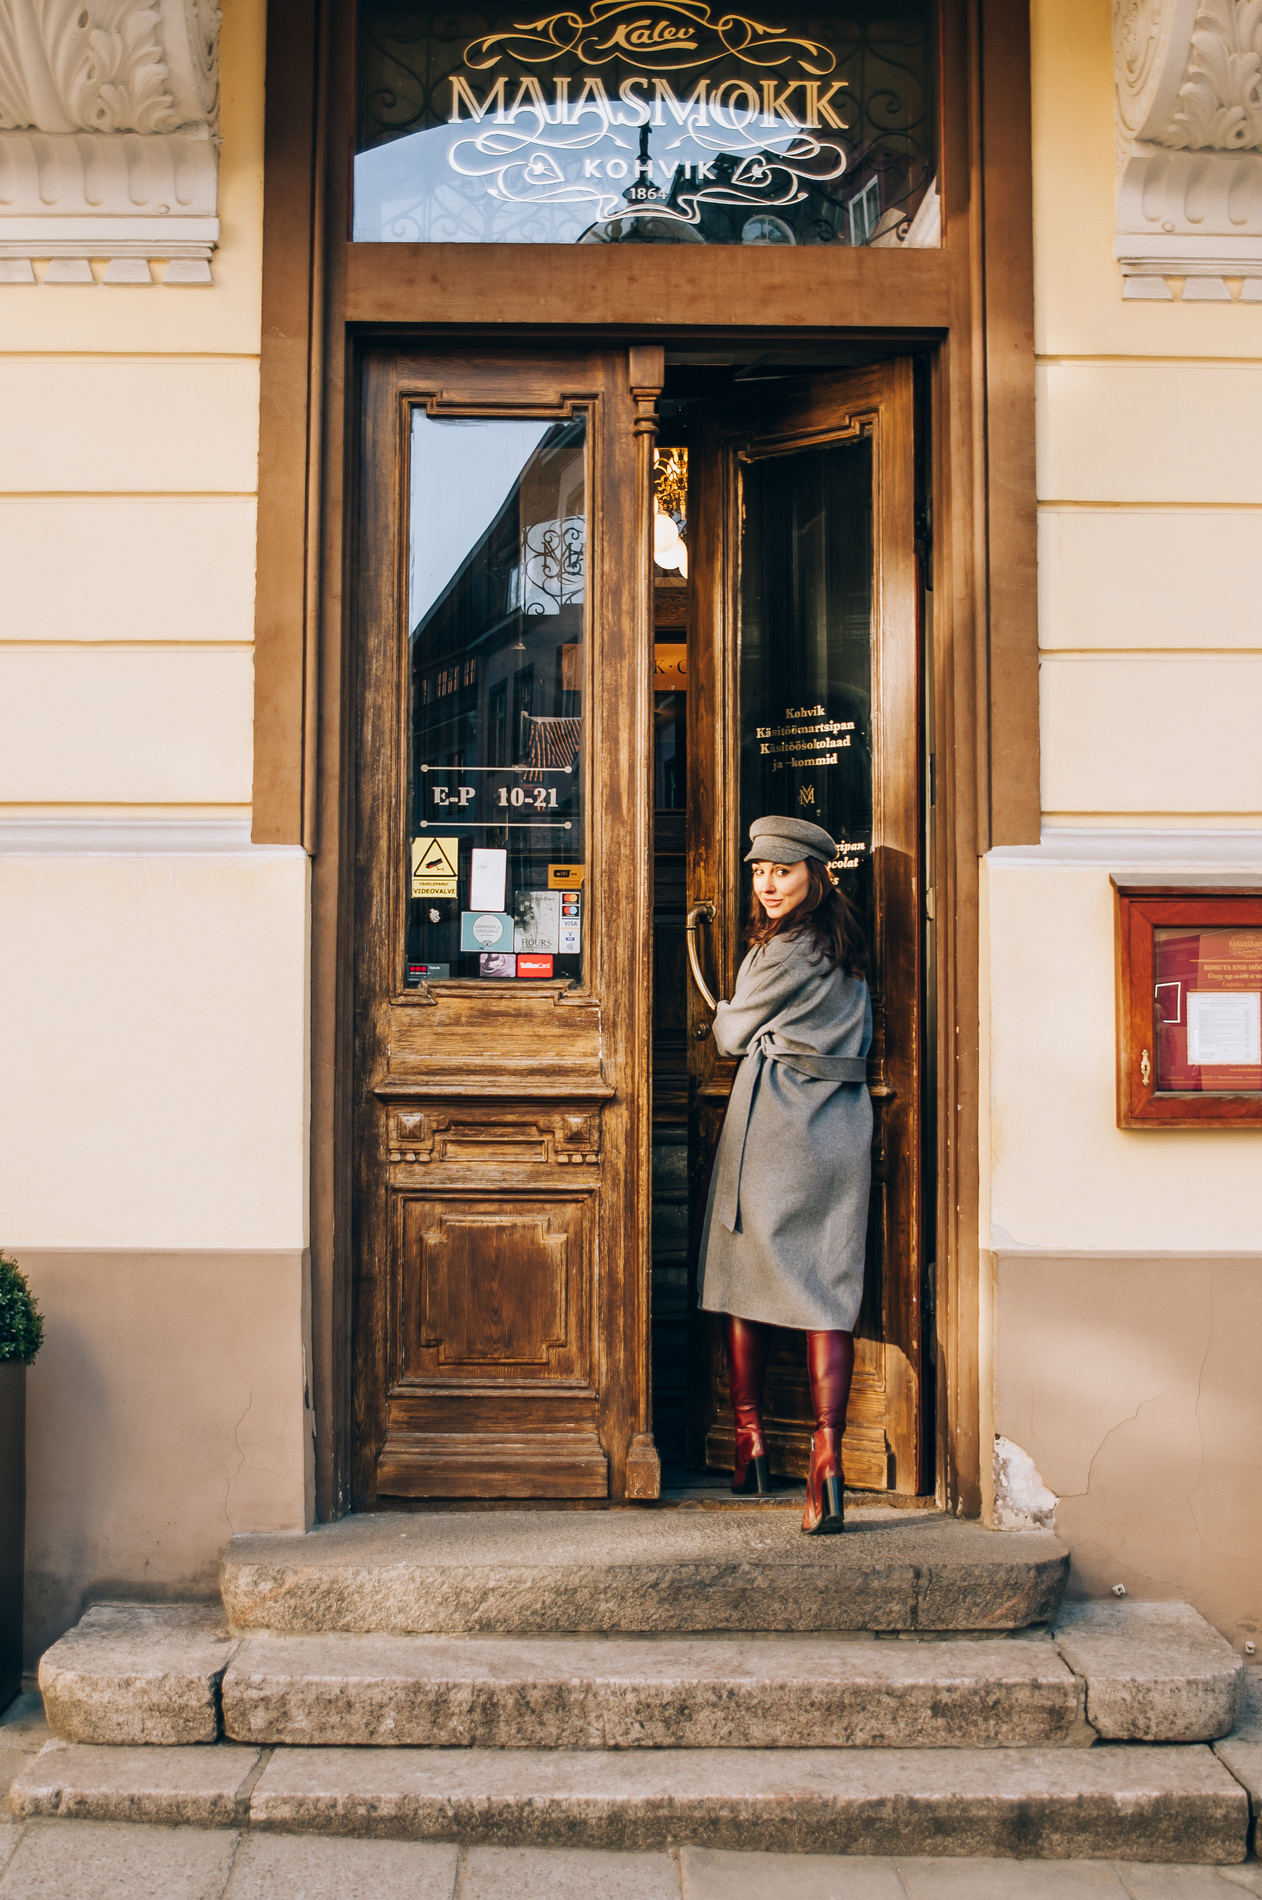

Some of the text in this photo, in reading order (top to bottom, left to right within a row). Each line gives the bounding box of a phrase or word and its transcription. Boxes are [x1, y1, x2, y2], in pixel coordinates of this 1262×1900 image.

[594, 19, 699, 52] Kalev
[448, 75, 850, 129] MAIASMOKK
[584, 158, 717, 181] KOHVIK
[629, 187, 668, 200] 1864
[785, 704, 826, 720] Kohvik
[771, 759, 784, 772] ja
[432, 786, 559, 808] E-P 10-21
[521, 938, 552, 947] HOURS
